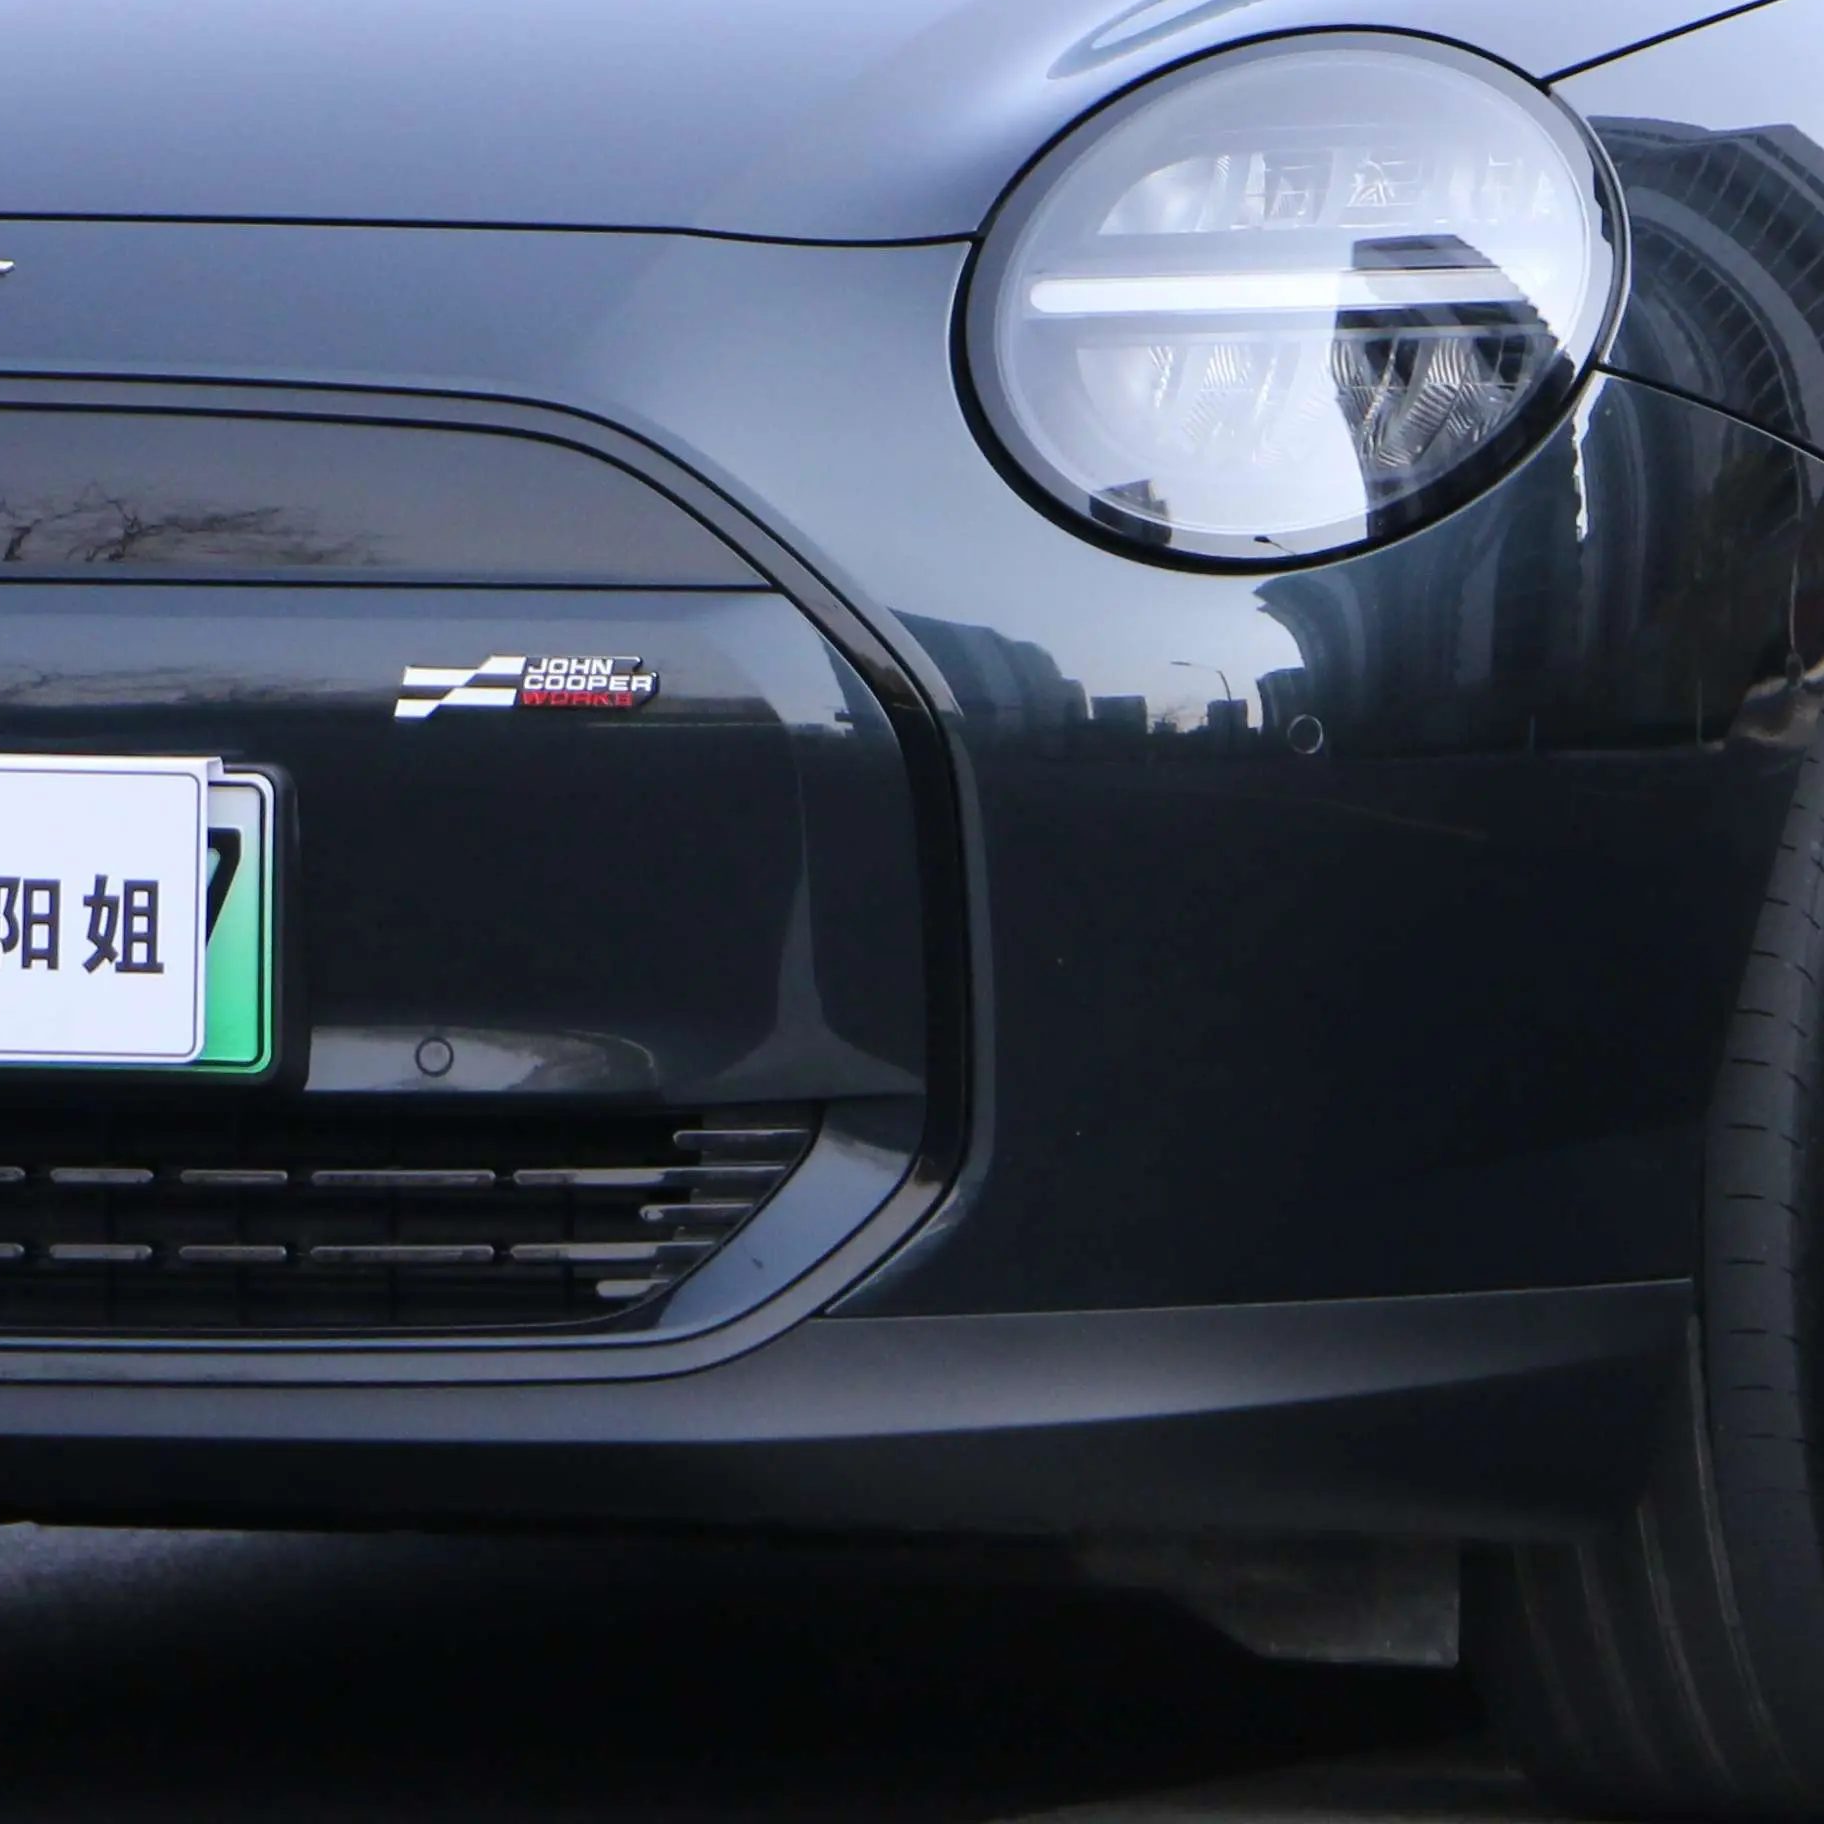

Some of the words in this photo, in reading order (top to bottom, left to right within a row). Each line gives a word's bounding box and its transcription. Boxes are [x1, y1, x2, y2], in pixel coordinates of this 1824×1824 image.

[527, 657, 615, 675] JOHN
[522, 675, 653, 692] COOPER
[521, 691, 634, 707] WORKS
